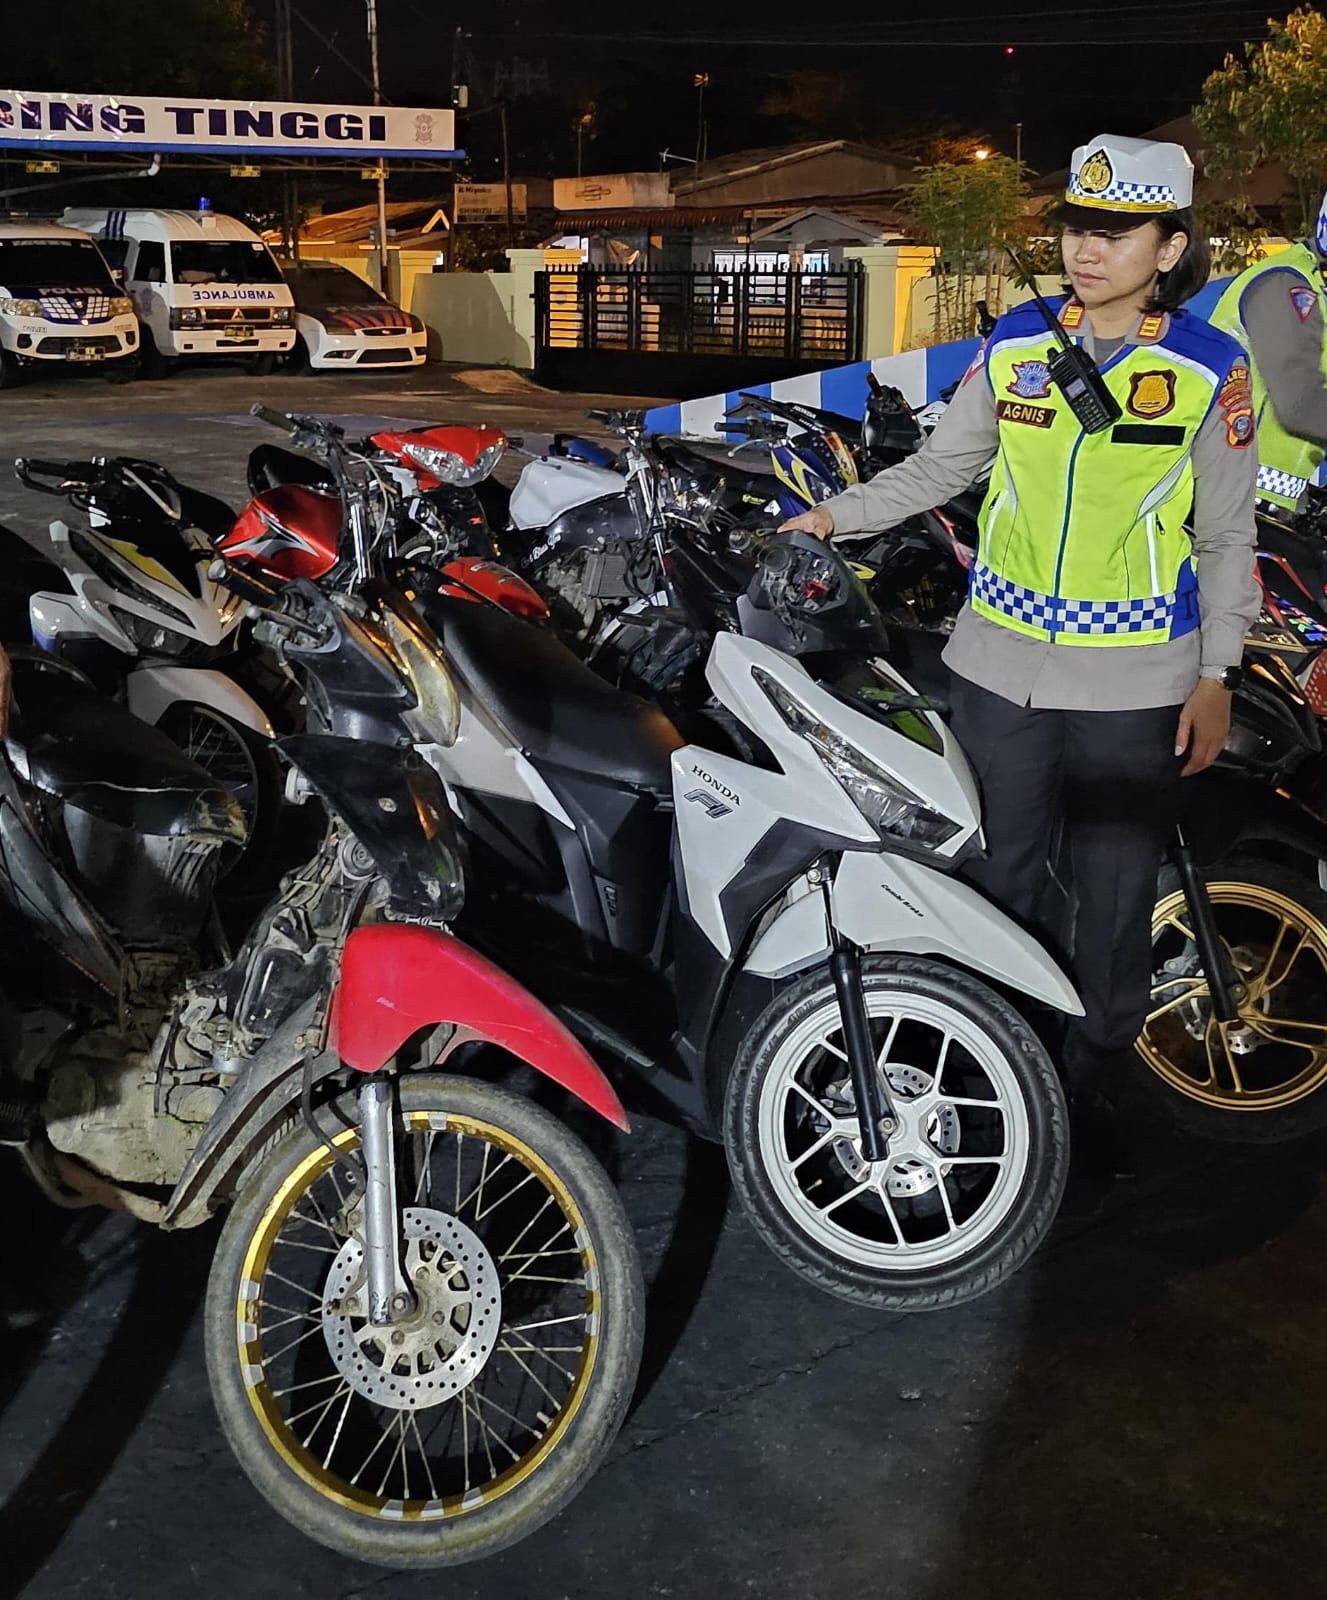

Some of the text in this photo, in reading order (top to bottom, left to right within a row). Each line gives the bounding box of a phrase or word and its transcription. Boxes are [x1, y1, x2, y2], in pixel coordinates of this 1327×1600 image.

[164, 106, 386, 141] TINGGI
[38, 287, 104, 296] POLISI
[1002, 404, 1046, 423] AGNIS
[692, 764, 741, 806] HONDA
